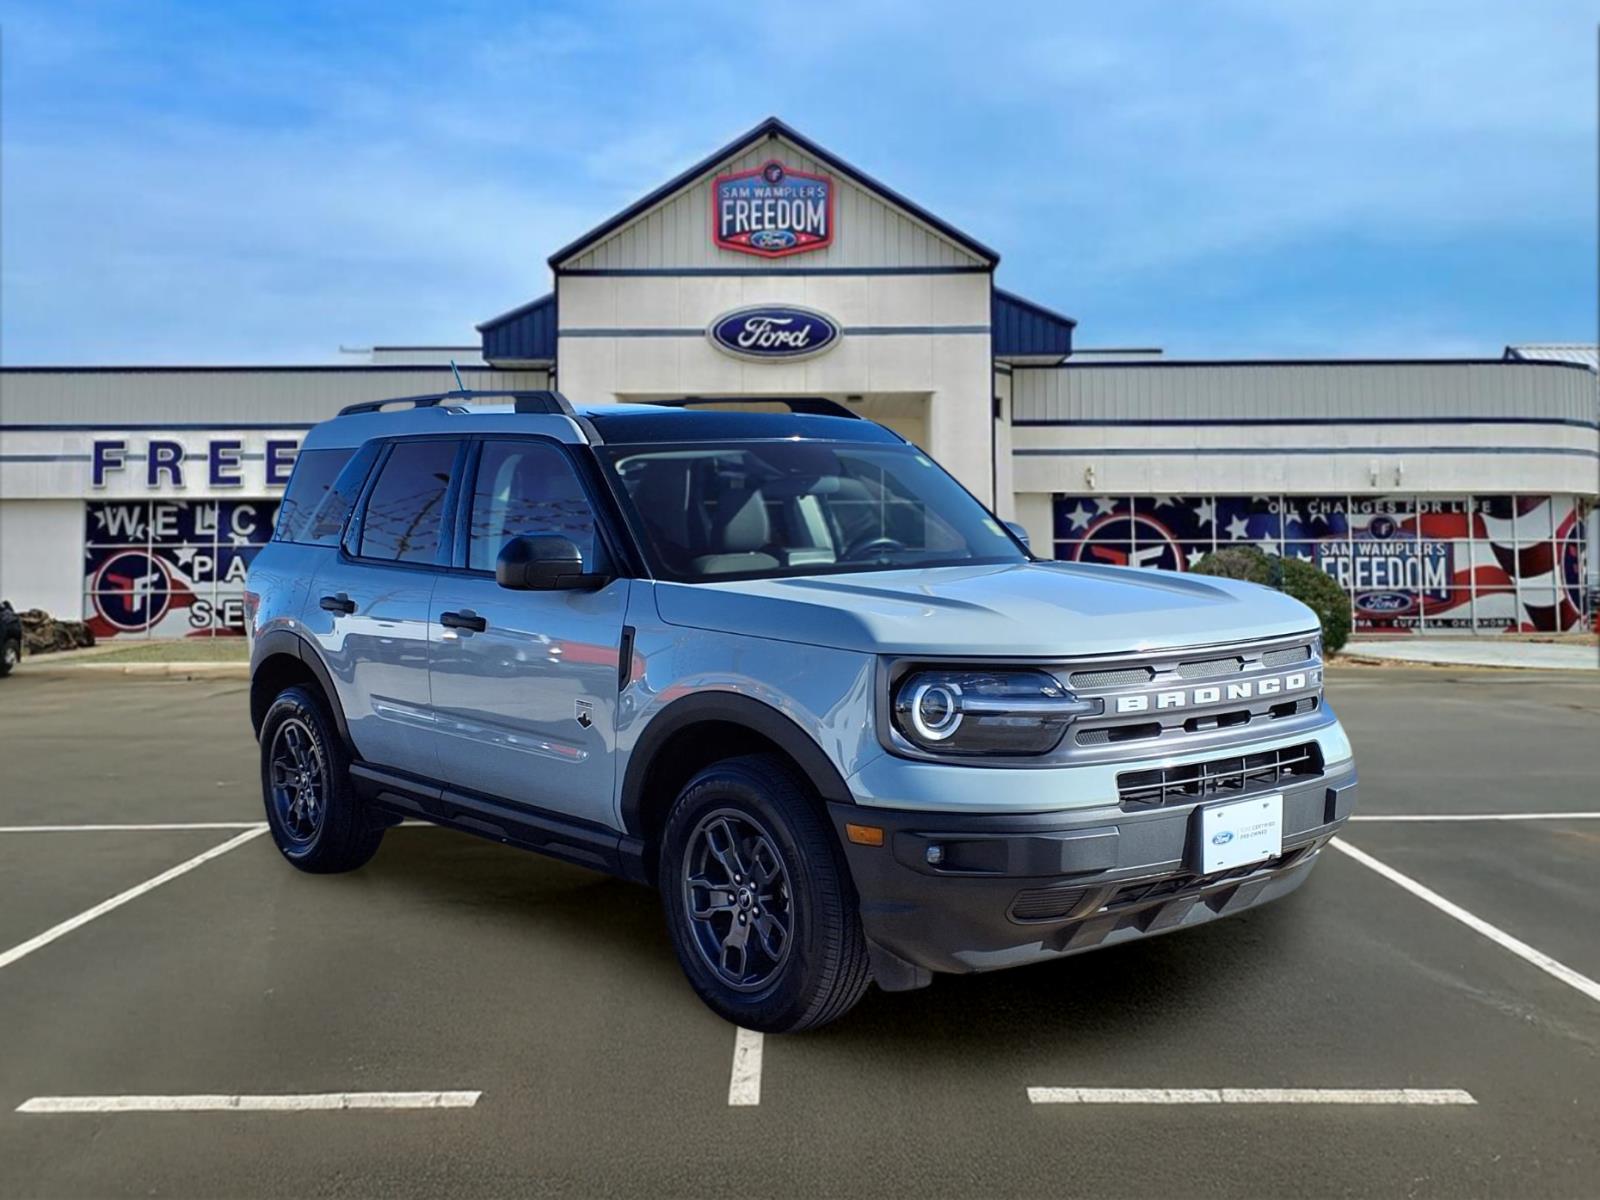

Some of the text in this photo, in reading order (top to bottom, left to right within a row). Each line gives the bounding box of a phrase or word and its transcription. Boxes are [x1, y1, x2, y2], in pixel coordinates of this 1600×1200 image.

[721, 187, 750, 198] SAM
[721, 199, 826, 236] FREEDOM
[737, 317, 811, 347] Ford
[92, 439, 298, 488] FREE
[1268, 501, 1491, 514] OIL CHANGES FOR LIFE
[1321, 556, 1447, 599] FREEDOM
[190, 601, 244, 628] SE
[1366, 595, 1400, 608] Ford
[1116, 673, 1305, 713] BRONCO
